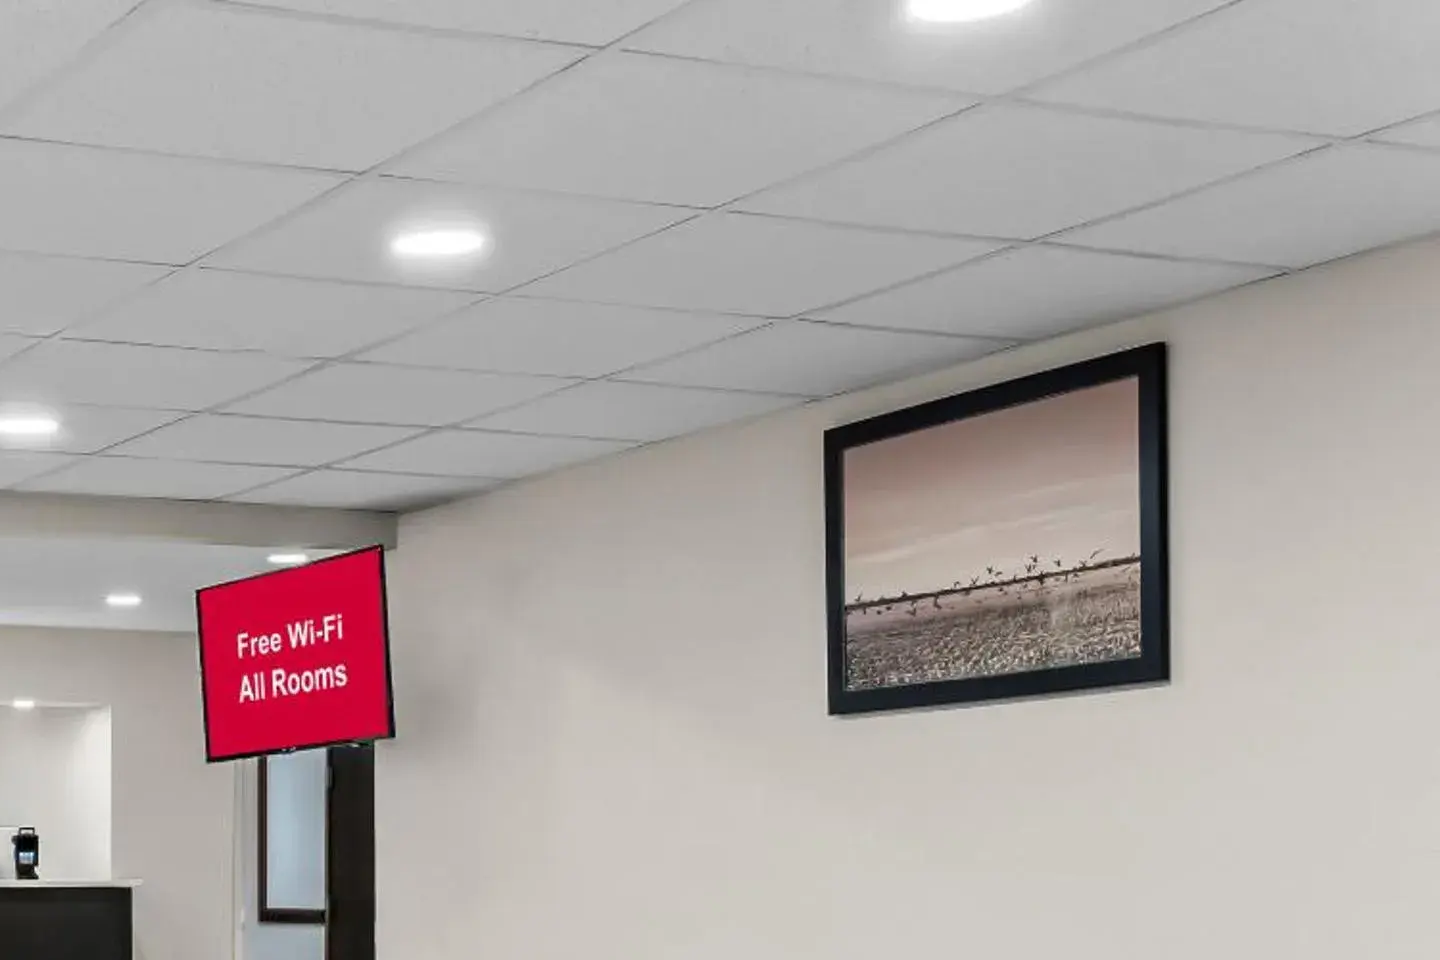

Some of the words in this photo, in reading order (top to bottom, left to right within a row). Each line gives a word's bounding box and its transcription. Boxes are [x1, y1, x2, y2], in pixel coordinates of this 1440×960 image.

[237, 632, 282, 659] Free
[286, 614, 344, 649] Wi-Fi
[239, 672, 266, 704] All
[272, 663, 348, 698] Rooms
